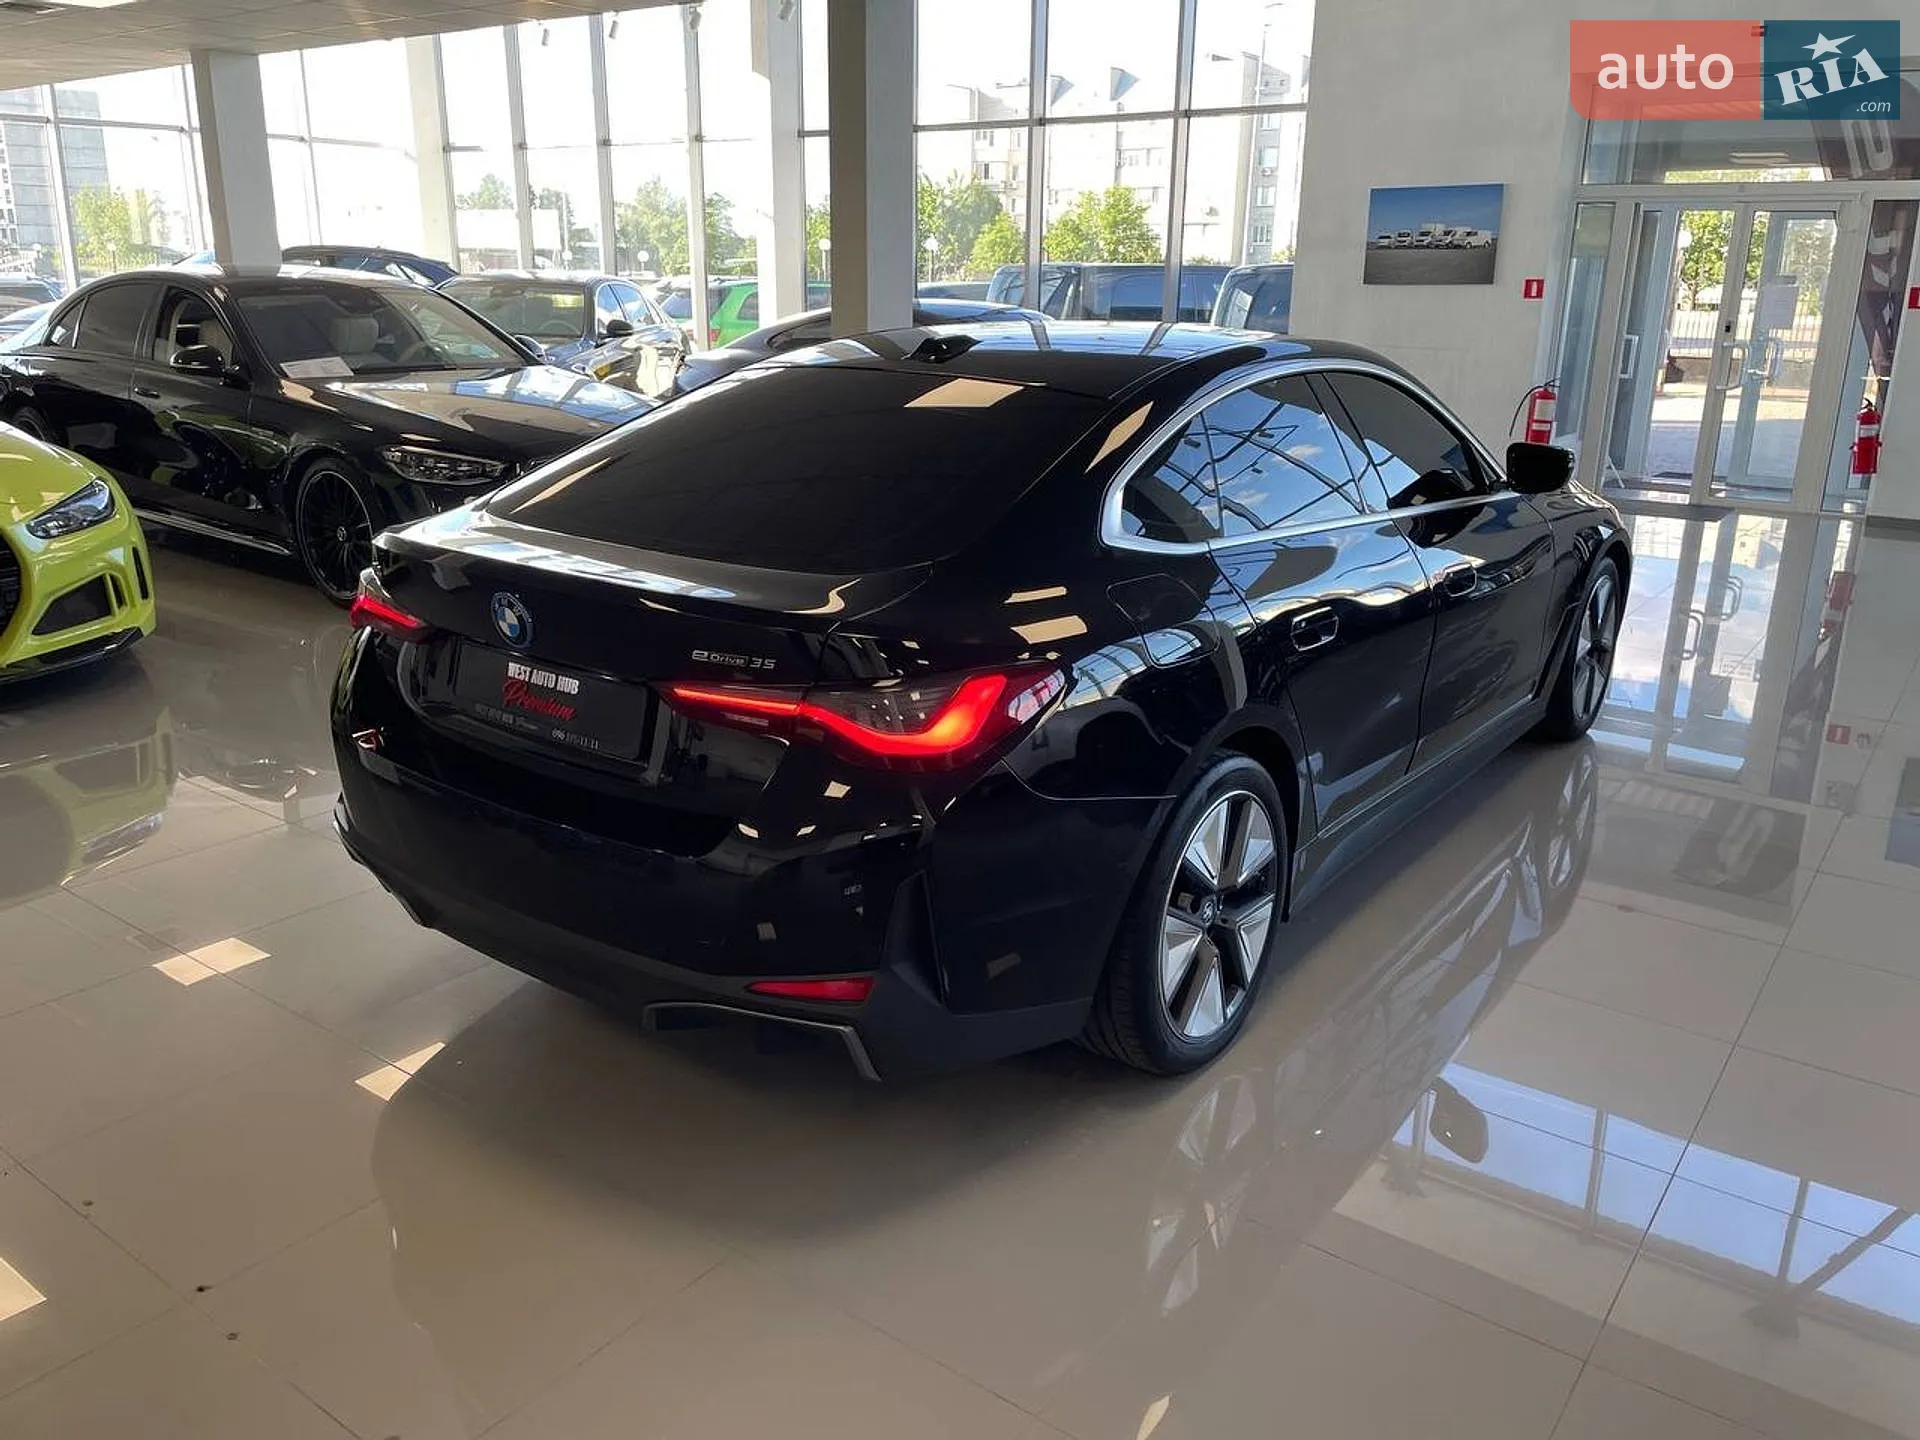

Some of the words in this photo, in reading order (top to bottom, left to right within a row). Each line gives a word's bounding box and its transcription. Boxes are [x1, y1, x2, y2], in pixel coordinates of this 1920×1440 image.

[749, 657, 777, 669] 35
[507, 661, 532, 682] WEST
[530, 670, 556, 689] AUTO
[556, 674, 580, 695] HUB
